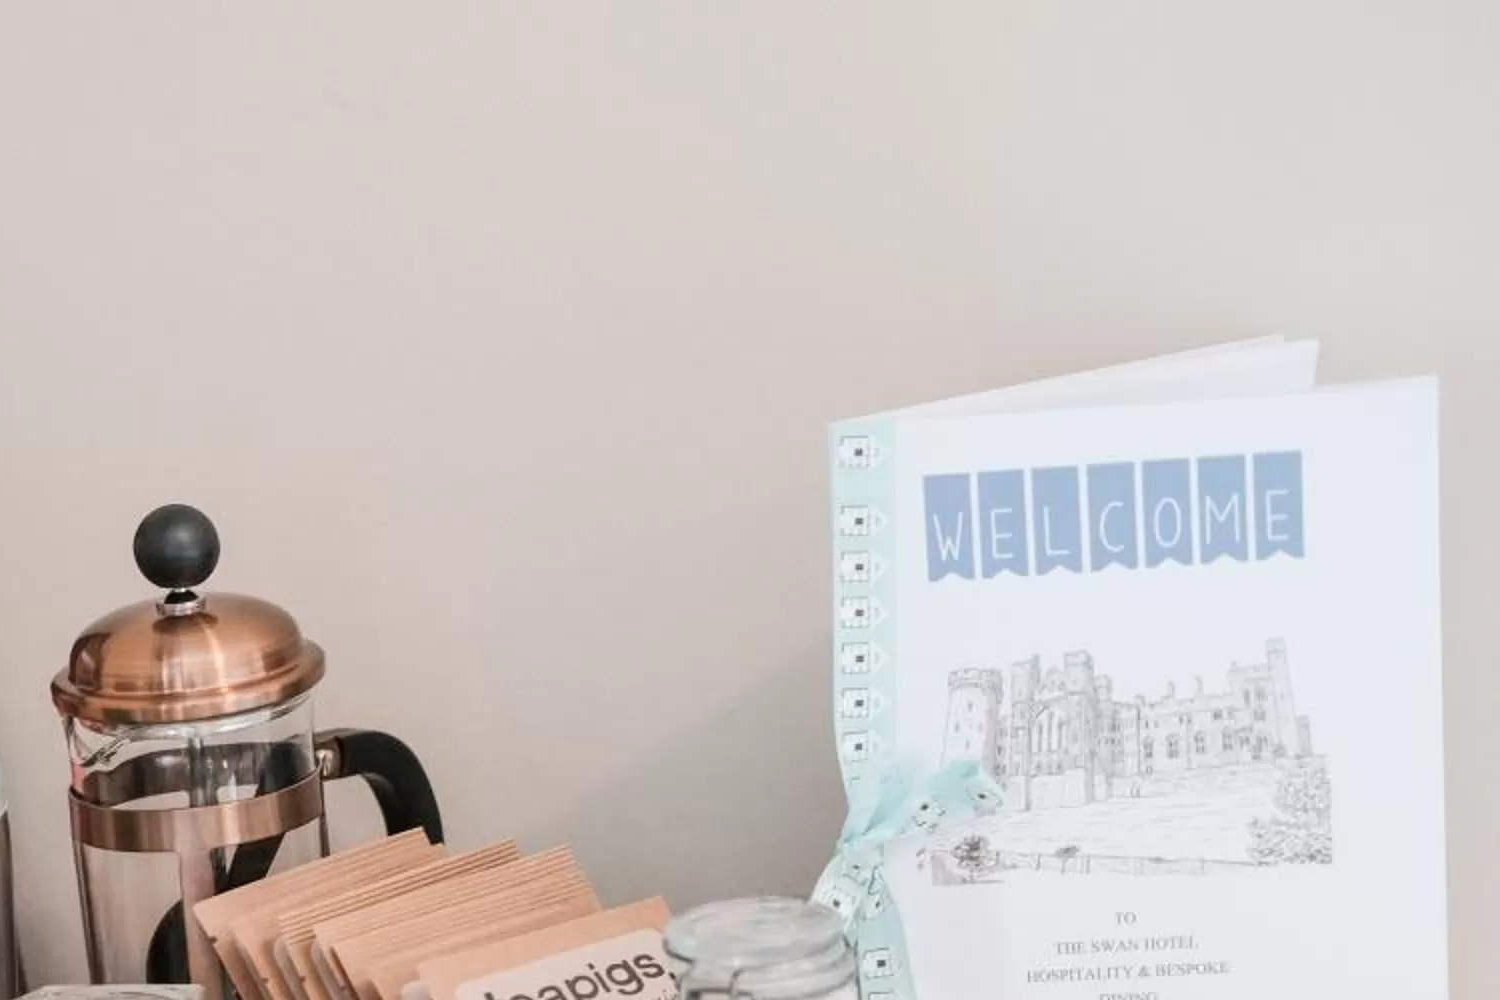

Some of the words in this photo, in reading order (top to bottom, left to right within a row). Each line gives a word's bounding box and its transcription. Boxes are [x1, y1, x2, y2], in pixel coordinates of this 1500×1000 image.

[932, 488, 1290, 562] WELCOME
[1115, 911, 1137, 925] TO
[1056, 940, 1085, 955] THE
[1090, 938, 1140, 954] SWAN
[1026, 965, 1133, 983] HOSPITALITY
[1137, 964, 1152, 978] &
[1155, 960, 1231, 977] BESPOKE
